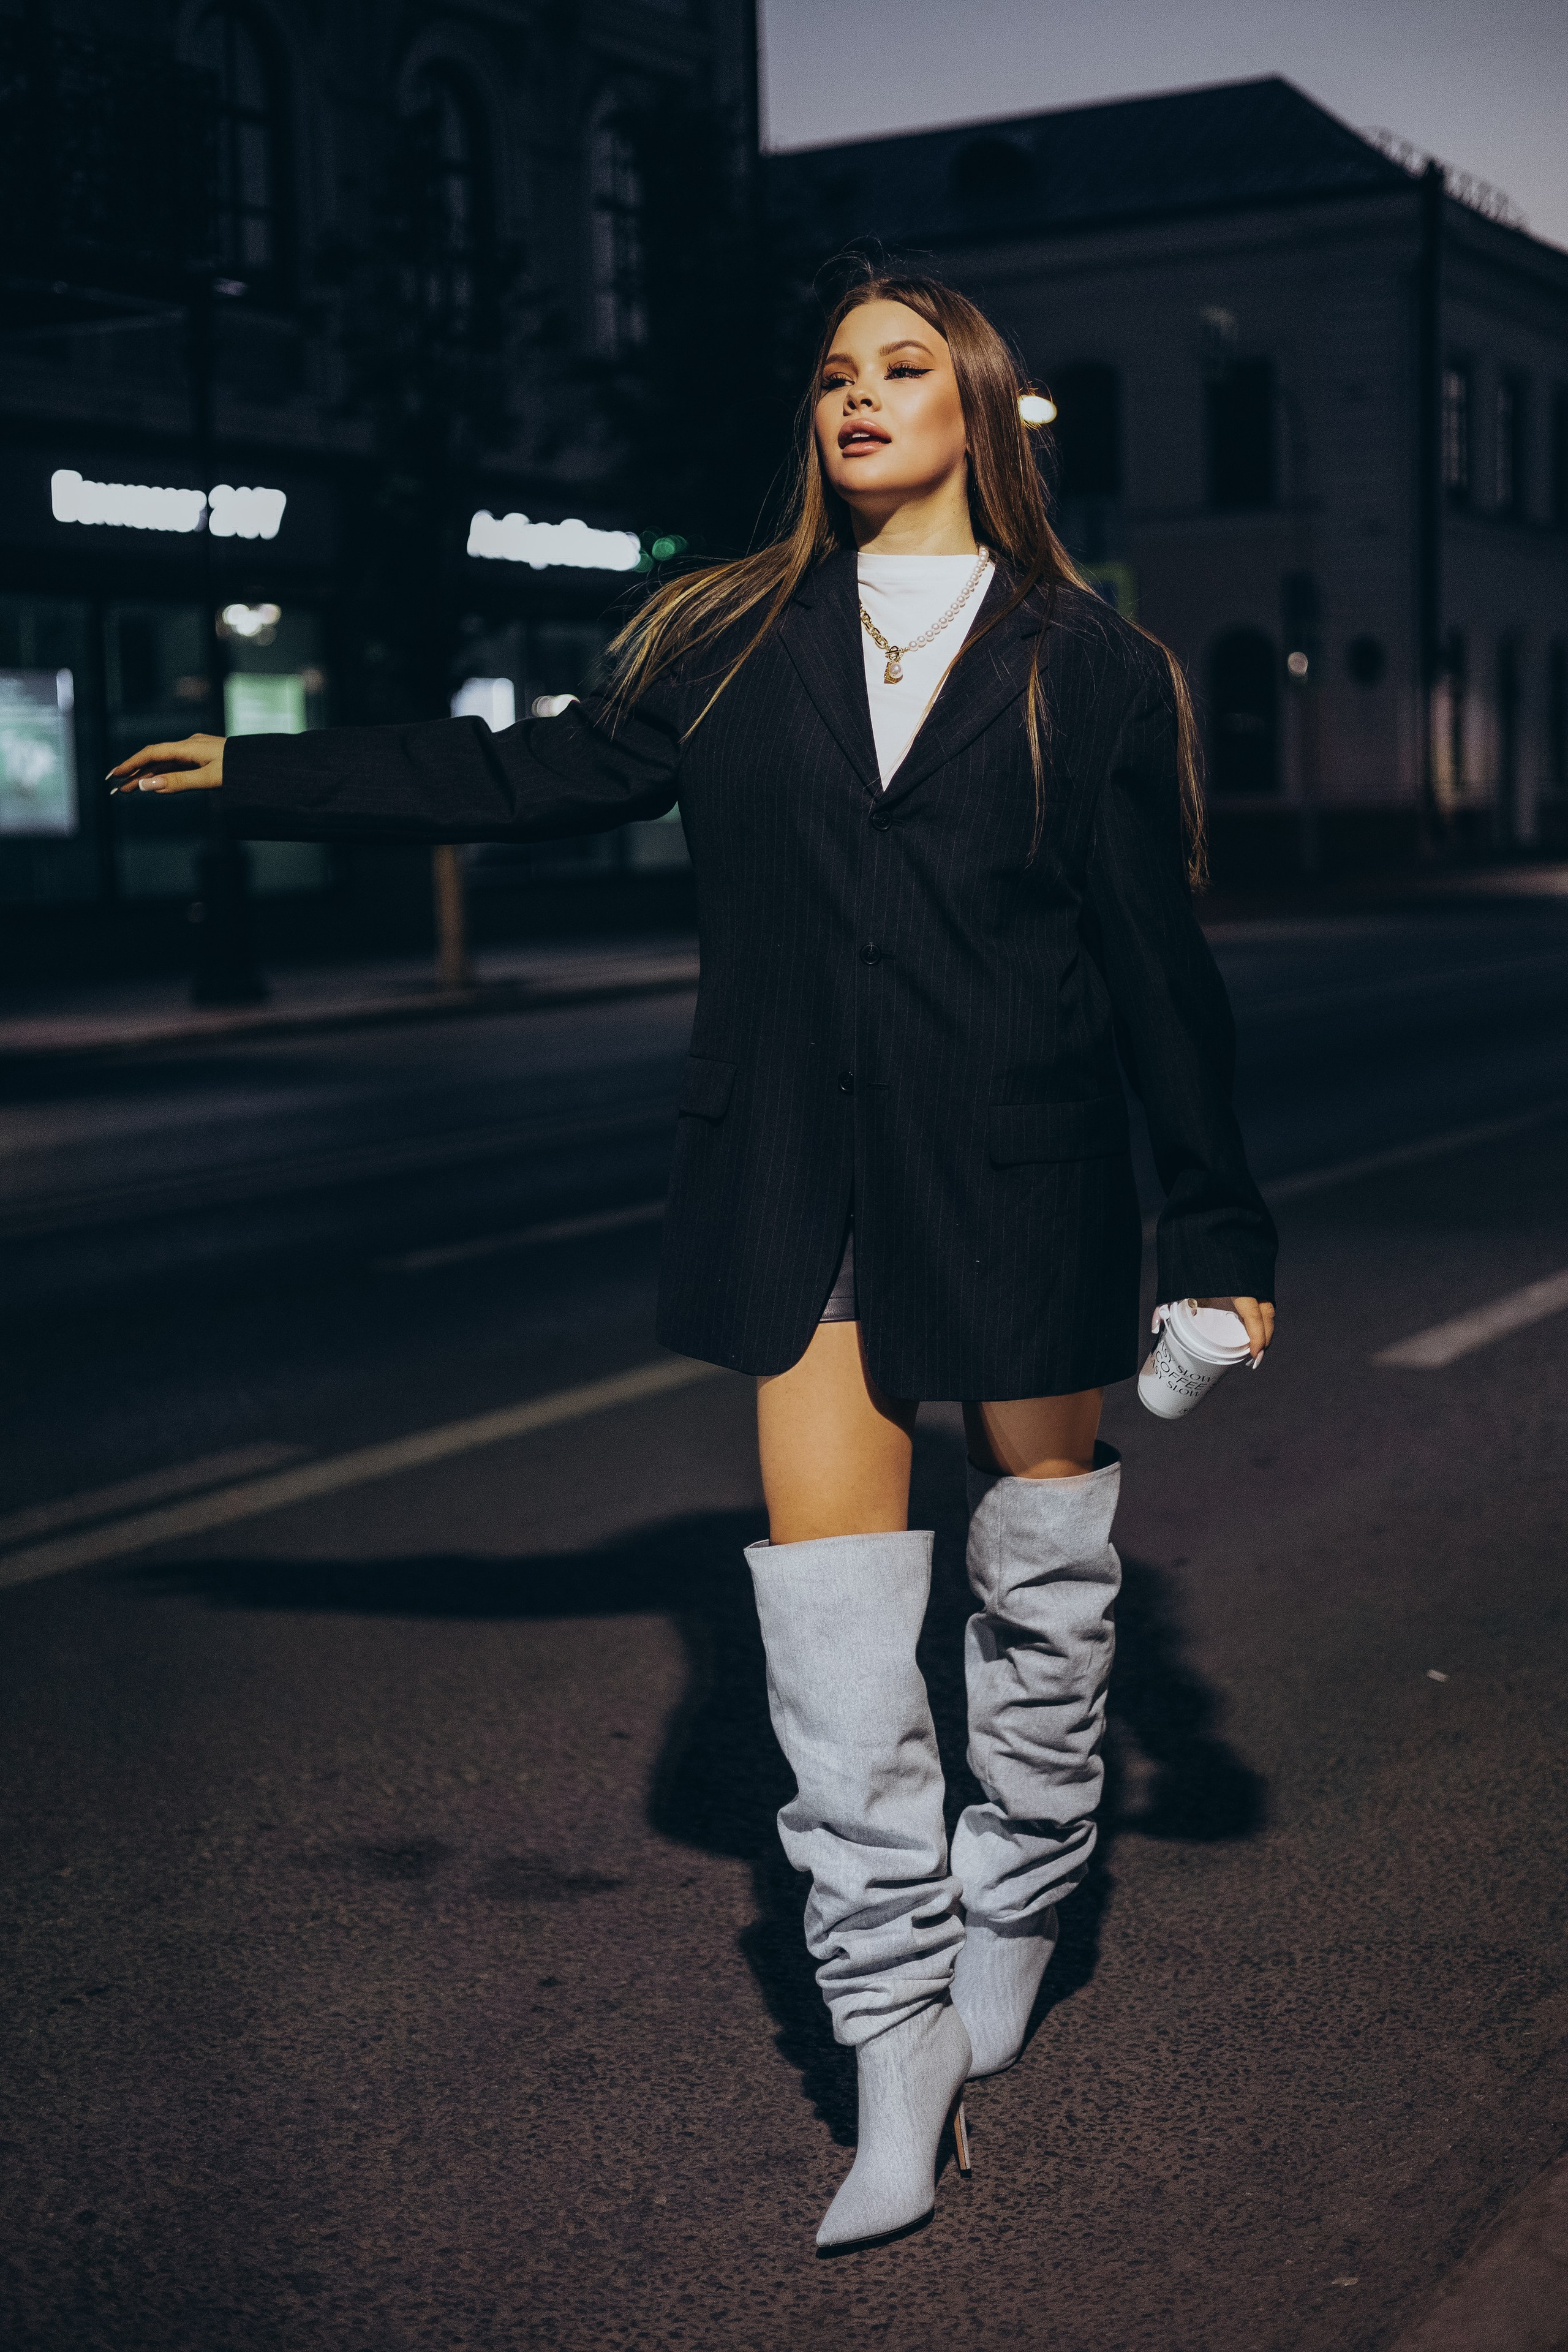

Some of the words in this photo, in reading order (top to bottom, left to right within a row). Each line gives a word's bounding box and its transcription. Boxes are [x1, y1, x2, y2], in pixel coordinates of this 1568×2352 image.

[1159, 1341, 1176, 1363] ASY
[1150, 1357, 1166, 1379] ASY
[1156, 1351, 1207, 1390] COFFEE
